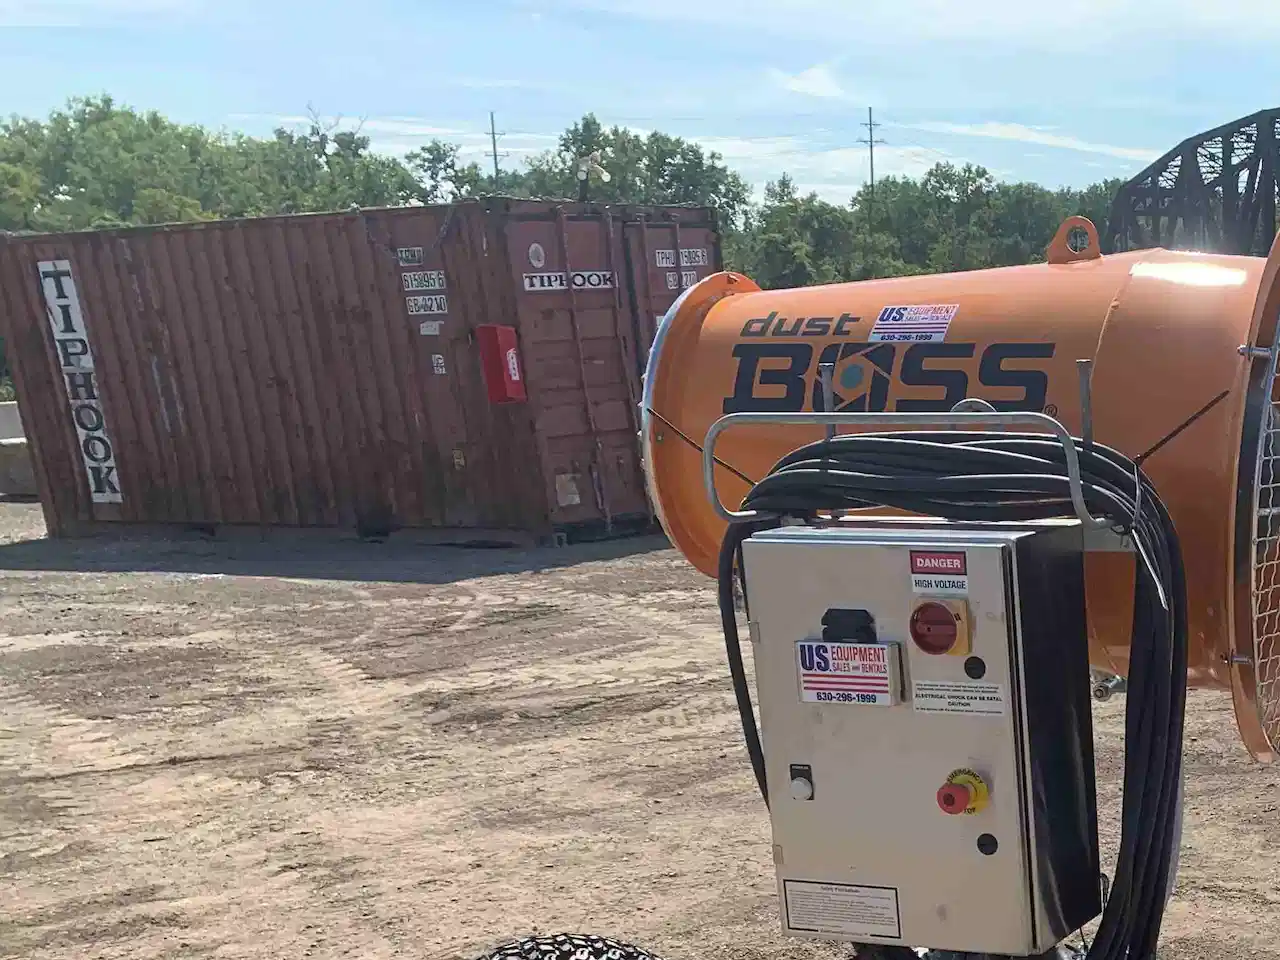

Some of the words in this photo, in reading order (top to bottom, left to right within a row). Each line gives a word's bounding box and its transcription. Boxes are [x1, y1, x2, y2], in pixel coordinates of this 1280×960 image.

[740, 311, 862, 337] dust
[42, 270, 120, 494] TIPHOOK
[722, 342, 1056, 414] BOSS
[915, 557, 961, 569] DANGER
[914, 579, 933, 588] HIGH
[934, 580, 967, 589] VOLTAGE
[831, 646, 886, 663] EQUIPMENT
[832, 662, 850, 673] SALES
[861, 663, 887, 674] RENTALS
